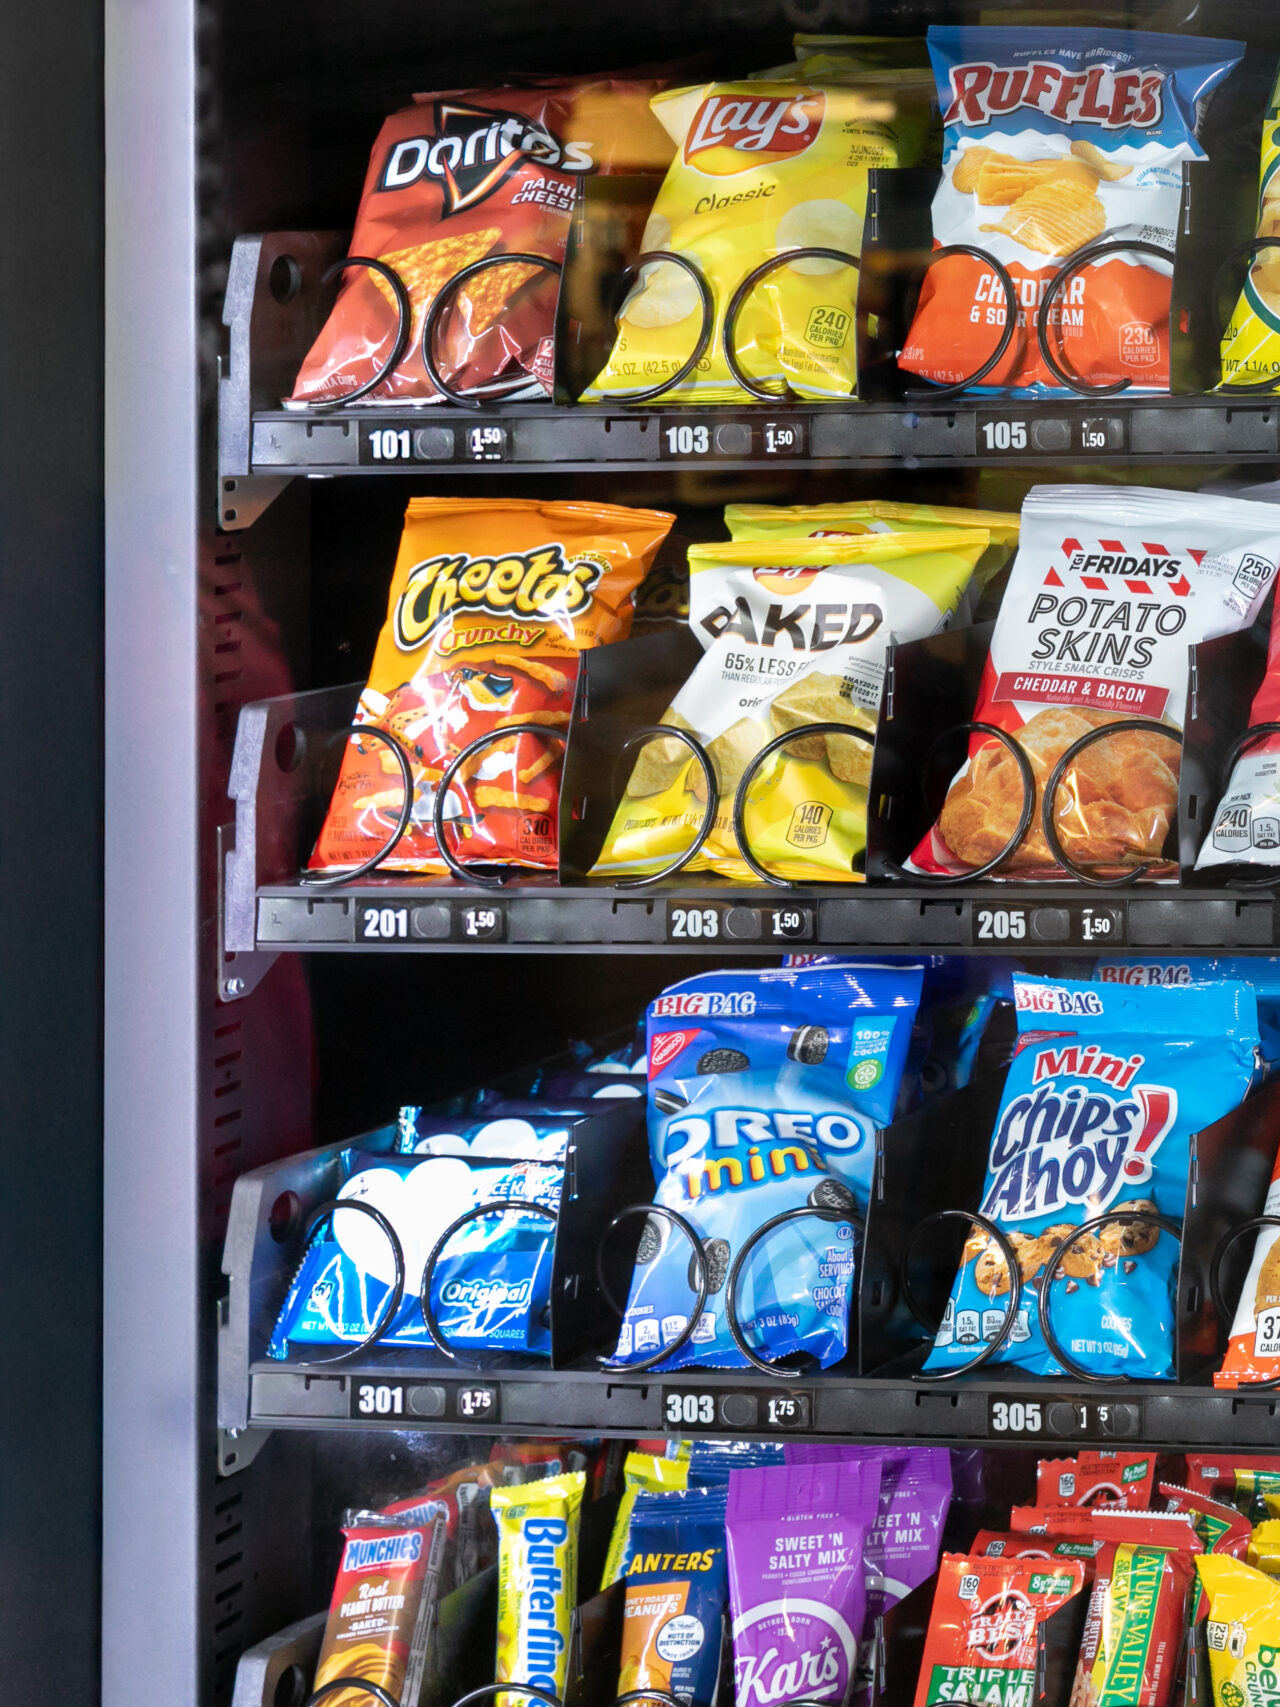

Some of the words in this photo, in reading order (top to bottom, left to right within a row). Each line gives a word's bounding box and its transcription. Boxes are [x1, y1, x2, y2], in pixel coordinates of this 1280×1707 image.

[943, 62, 1166, 128] RUFFLES
[688, 94, 819, 151] Lay's
[383, 117, 594, 188] Doritos
[693, 182, 777, 216] Classic
[974, 274, 1087, 308] CHEDAR
[809, 324, 844, 340] CALORIES
[813, 308, 846, 330] 240
[1124, 327, 1154, 346] 230
[1122, 346, 1157, 355] CALORIES
[369, 429, 410, 460] 101
[472, 427, 501, 454] 1.50
[665, 425, 709, 454] 103
[766, 428, 793, 453] 1.50
[982, 421, 1027, 449] 105
[1068, 553, 1086, 572] TGI
[1082, 554, 1182, 579] FRIDAYS
[1241, 558, 1272, 580] 250
[398, 547, 596, 646] Cheetos
[1027, 593, 1187, 636] POTATO
[436, 623, 546, 656] Crunchy
[1031, 628, 1158, 669] SKINS
[724, 652, 754, 671] 65%
[759, 654, 796, 677] LESS
[1028, 660, 1062, 673] STYLE
[1063, 662, 1101, 675] SNACK
[1103, 665, 1145, 681] CRISPS
[1013, 676, 1075, 697] CHEDDAR
[1081, 681, 1092, 697] &
[1097, 681, 1147, 703] BACON
[800, 805, 824, 825] 140
[1218, 808, 1247, 828] 240
[794, 825, 822, 835] CALORIES
[364, 908, 407, 938] 201
[466, 911, 495, 935] 1.50
[671, 909, 719, 938] 203
[771, 912, 799, 935] 1.50
[977, 910, 1026, 939] 205
[1082, 917, 1110, 940] 1.50
[652, 993, 704, 1016] BIG
[705, 992, 756, 1016] BAG
[1015, 987, 1055, 1012] BIG
[1059, 991, 1102, 1016] BAG
[852, 1045, 887, 1057] COCOA
[1032, 1045, 1145, 1090] Mini
[666, 1110, 861, 1164] OREO
[990, 1083, 1141, 1173] Chips
[443, 1280, 531, 1309] Original
[358, 1385, 403, 1414] 301
[462, 1391, 492, 1415] 1.75
[667, 1395, 714, 1423] 303
[768, 1400, 795, 1423] 1.75
[992, 1402, 1041, 1431] 305
[775, 1535, 822, 1552] SWEET
[894, 1529, 922, 1544] MIX
[343, 1532, 423, 1572] MUNCHIES
[769, 1554, 811, 1570] SALTY
[819, 1548, 848, 1564] MIX
[359, 1580, 388, 1600] Real
[963, 1577, 979, 1589] 160
[340, 1599, 370, 1617] PEANUT
[370, 1595, 405, 1612] BUTTER
[658, 1637, 701, 1648] DISTINCTION
[1085, 1619, 1101, 1660] BUTTER
[1214, 1624, 1226, 1648] 230
[735, 1645, 842, 1707] Kar's
[941, 1666, 1035, 1685] TRIPLE
[1110, 1623, 1148, 1702] VALLEY
